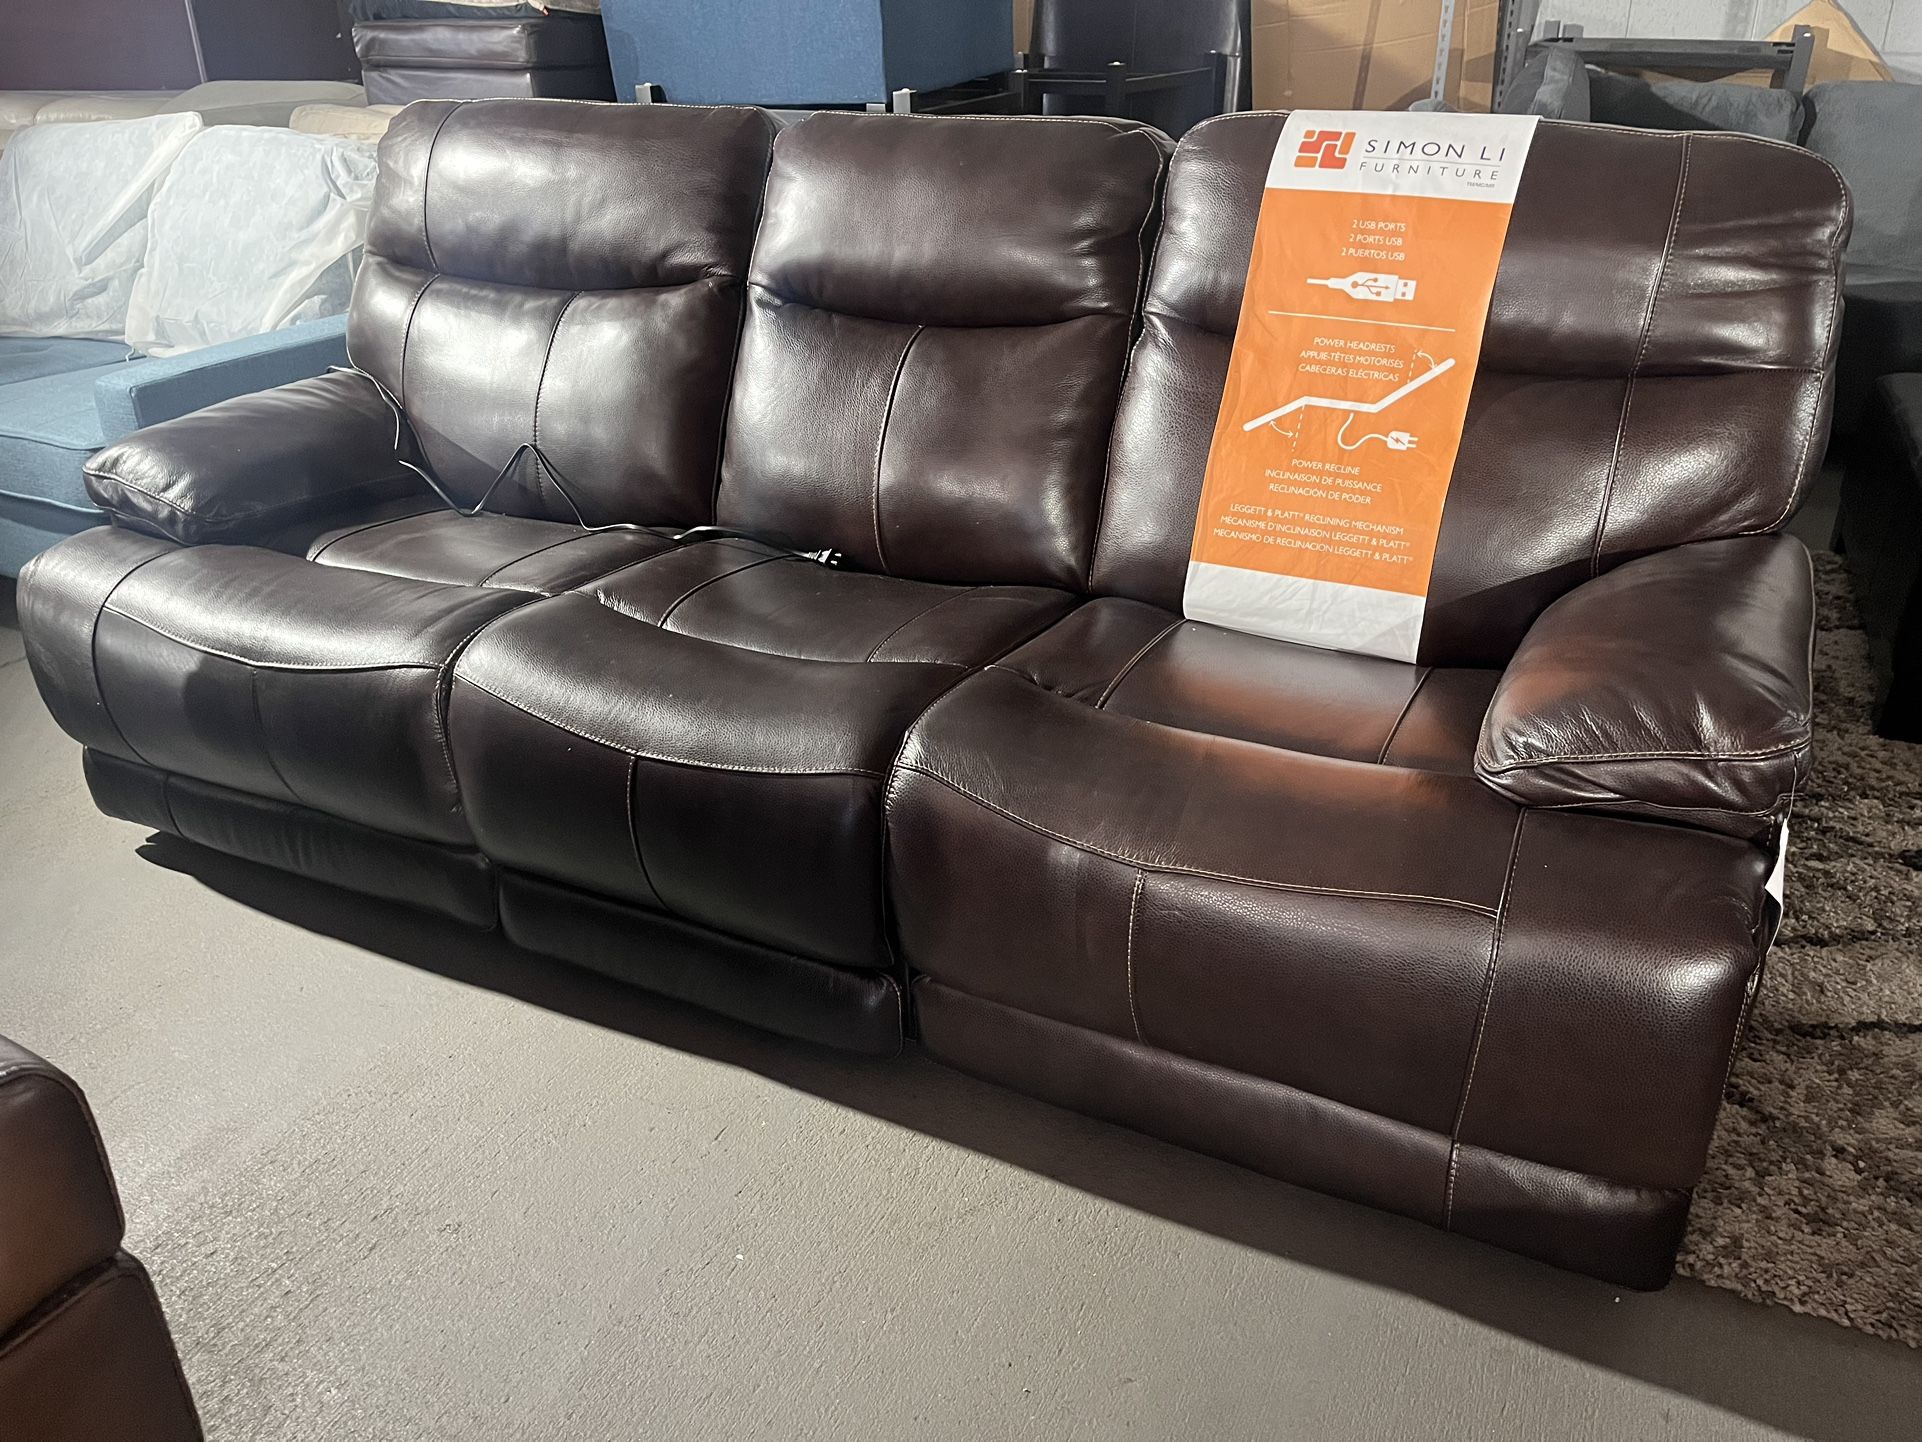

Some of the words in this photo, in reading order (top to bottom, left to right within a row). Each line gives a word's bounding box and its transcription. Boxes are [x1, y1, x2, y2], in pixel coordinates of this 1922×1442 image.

[1364, 139, 1465, 161] SIMON
[1480, 147, 1506, 162] LI
[1359, 162, 1499, 181] FURNITURE
[1352, 219, 1358, 228] 2
[1359, 220, 1376, 230] USB
[1377, 221, 1406, 232] PORTS
[1349, 233, 1355, 242] 2
[1355, 234, 1384, 244] PORTS
[1385, 237, 1403, 246] USB
[1341, 247, 1347, 256] 2
[1347, 248, 1387, 260] PUERTOS
[1388, 252, 1406, 261] USB
[1313, 337, 1345, 348] POWER
[1346, 340, 1396, 354] HEADRESTS
[1299, 350, 1354, 363] APPUIE-TÊTES
[1298, 363, 1347, 376] CABECERAS
[1291, 458, 1323, 470] POWER
[1324, 462, 1361, 475] RECLINE
[1265, 469, 1320, 484] INCLINAISON
[1321, 476, 1334, 485] DE
[1335, 478, 1383, 493] PUISSANCE
[1327, 491, 1340, 500] DE
[1341, 493, 1371, 505] PODER
[1230, 503, 1265, 515] LEGGETT
[1266, 509, 1273, 517] &
[1304, 513, 1350, 528] RECLINING
[1351, 521, 1404, 535] MECHANISM
[1213, 527, 1262, 542] MECANISMO
[1263, 535, 1276, 544] DE
[1334, 546, 1372, 558] LEGGETT
[1373, 552, 1380, 560] &
[1331, 531, 1369, 544] LEGGETT
[1370, 538, 1377, 546] &
